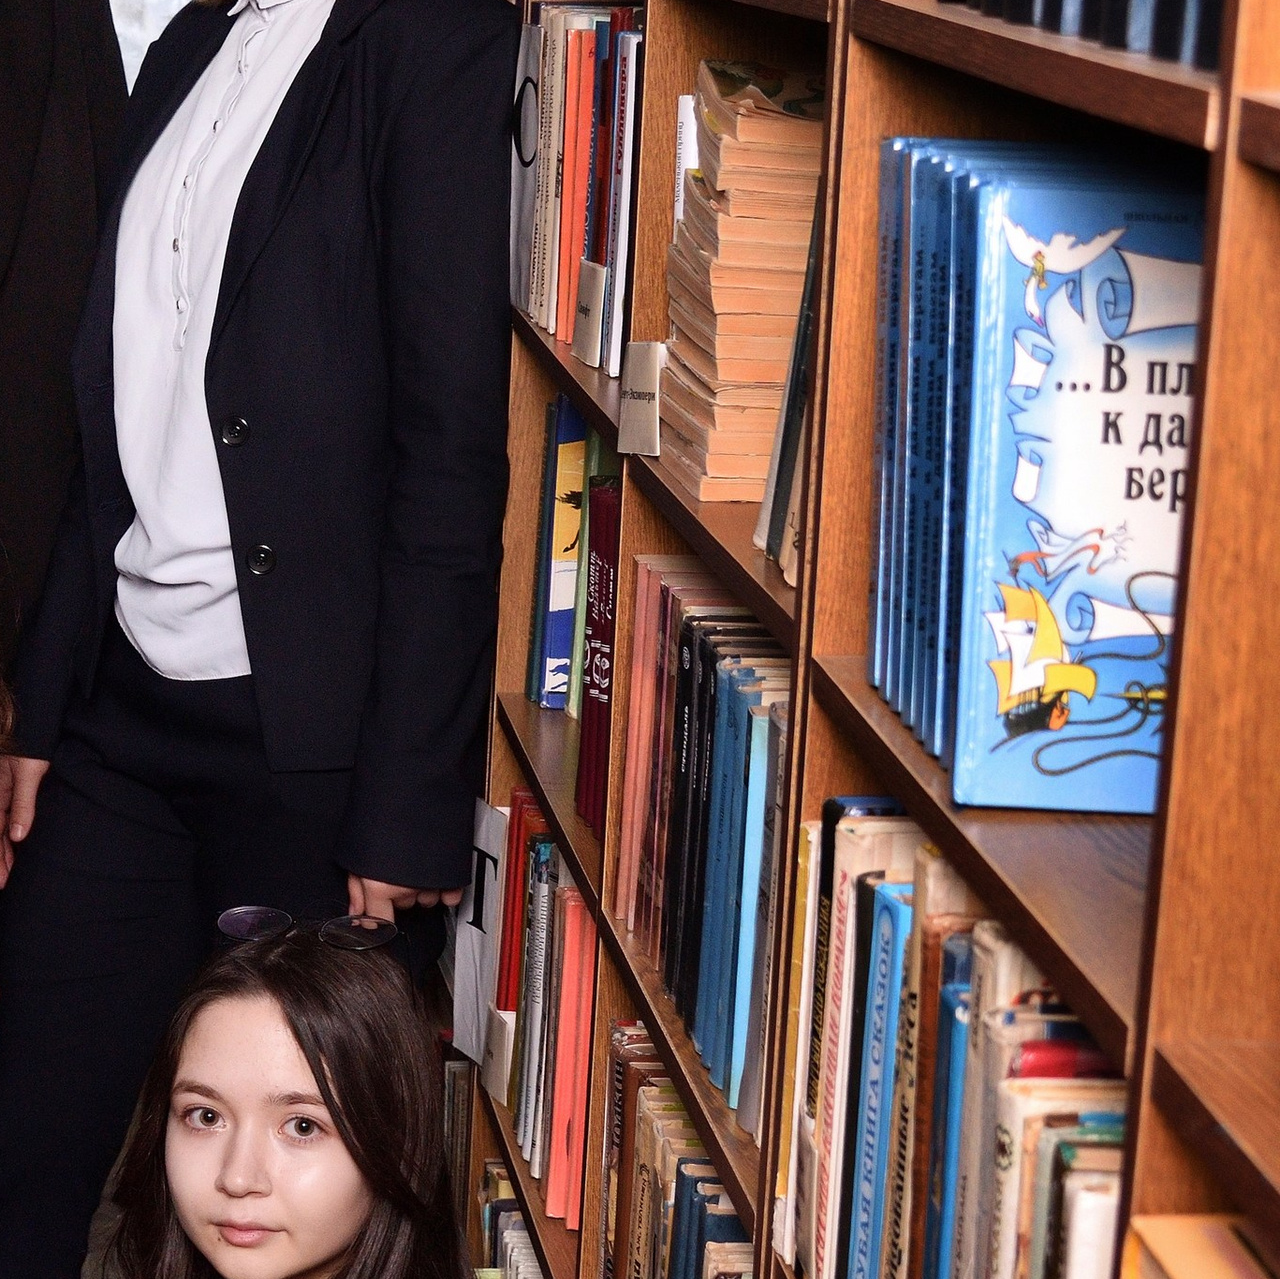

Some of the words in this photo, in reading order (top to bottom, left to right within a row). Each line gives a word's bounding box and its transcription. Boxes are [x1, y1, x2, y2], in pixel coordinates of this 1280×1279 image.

[1101, 411, 1124, 445] к
[862, 1079, 878, 1184] КНИГА
[872, 935, 891, 1064] СКАЗОК
